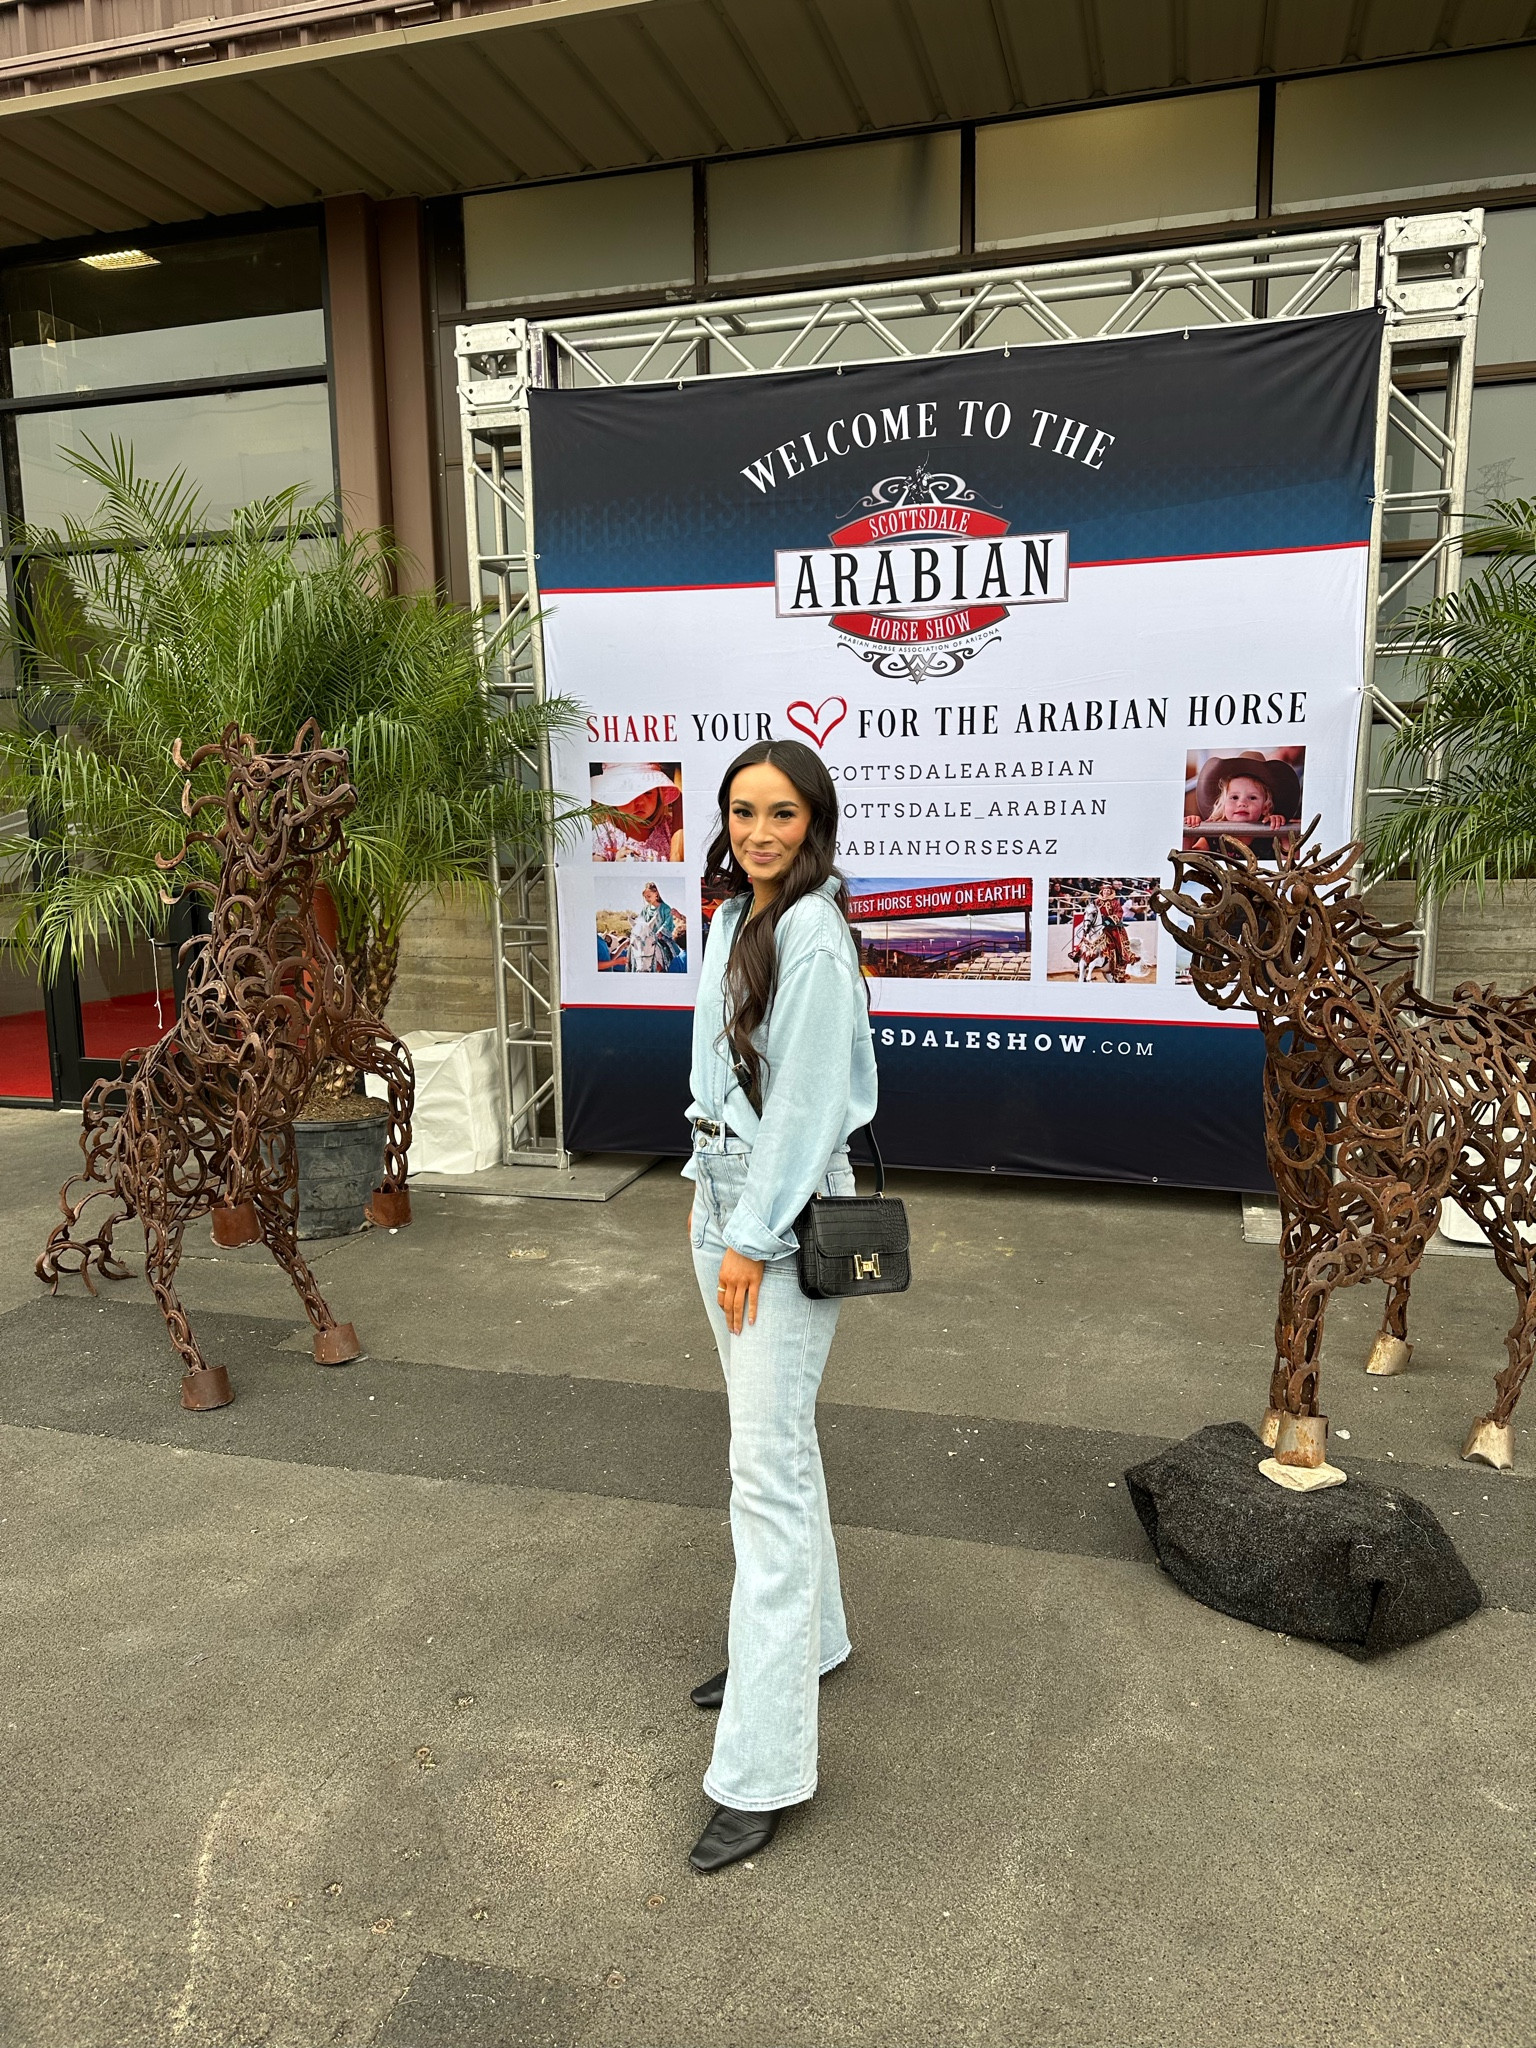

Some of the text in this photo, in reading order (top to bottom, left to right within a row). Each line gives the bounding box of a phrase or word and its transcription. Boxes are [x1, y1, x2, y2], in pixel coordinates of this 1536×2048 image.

[739, 400, 1116, 494] WELCOME TO THE
[868, 508, 971, 538] SCOTTSDALE
[790, 538, 1054, 610] ARABIAN
[838, 634, 869, 648] ARABIAN
[872, 643, 896, 652] HORSE
[898, 643, 950, 653] ASSOCIATION
[965, 627, 1000, 645] ARIZONA
[868, 611, 971, 642] HORSE SHOW
[587, 691, 1308, 743] SHARE YOUR FOR THE ARABIAN HORSE
[828, 760, 1095, 781] COTTSDALEARABIAN
[844, 799, 1107, 819] OTTSDALE_ARABIAN
[836, 839, 1058, 856] RABIANHORSESAZ
[848, 883, 1027, 914] ATEST HORSE SHOW ON EARTH!
[870, 1028, 1154, 1056] SDALESHOW.COM
